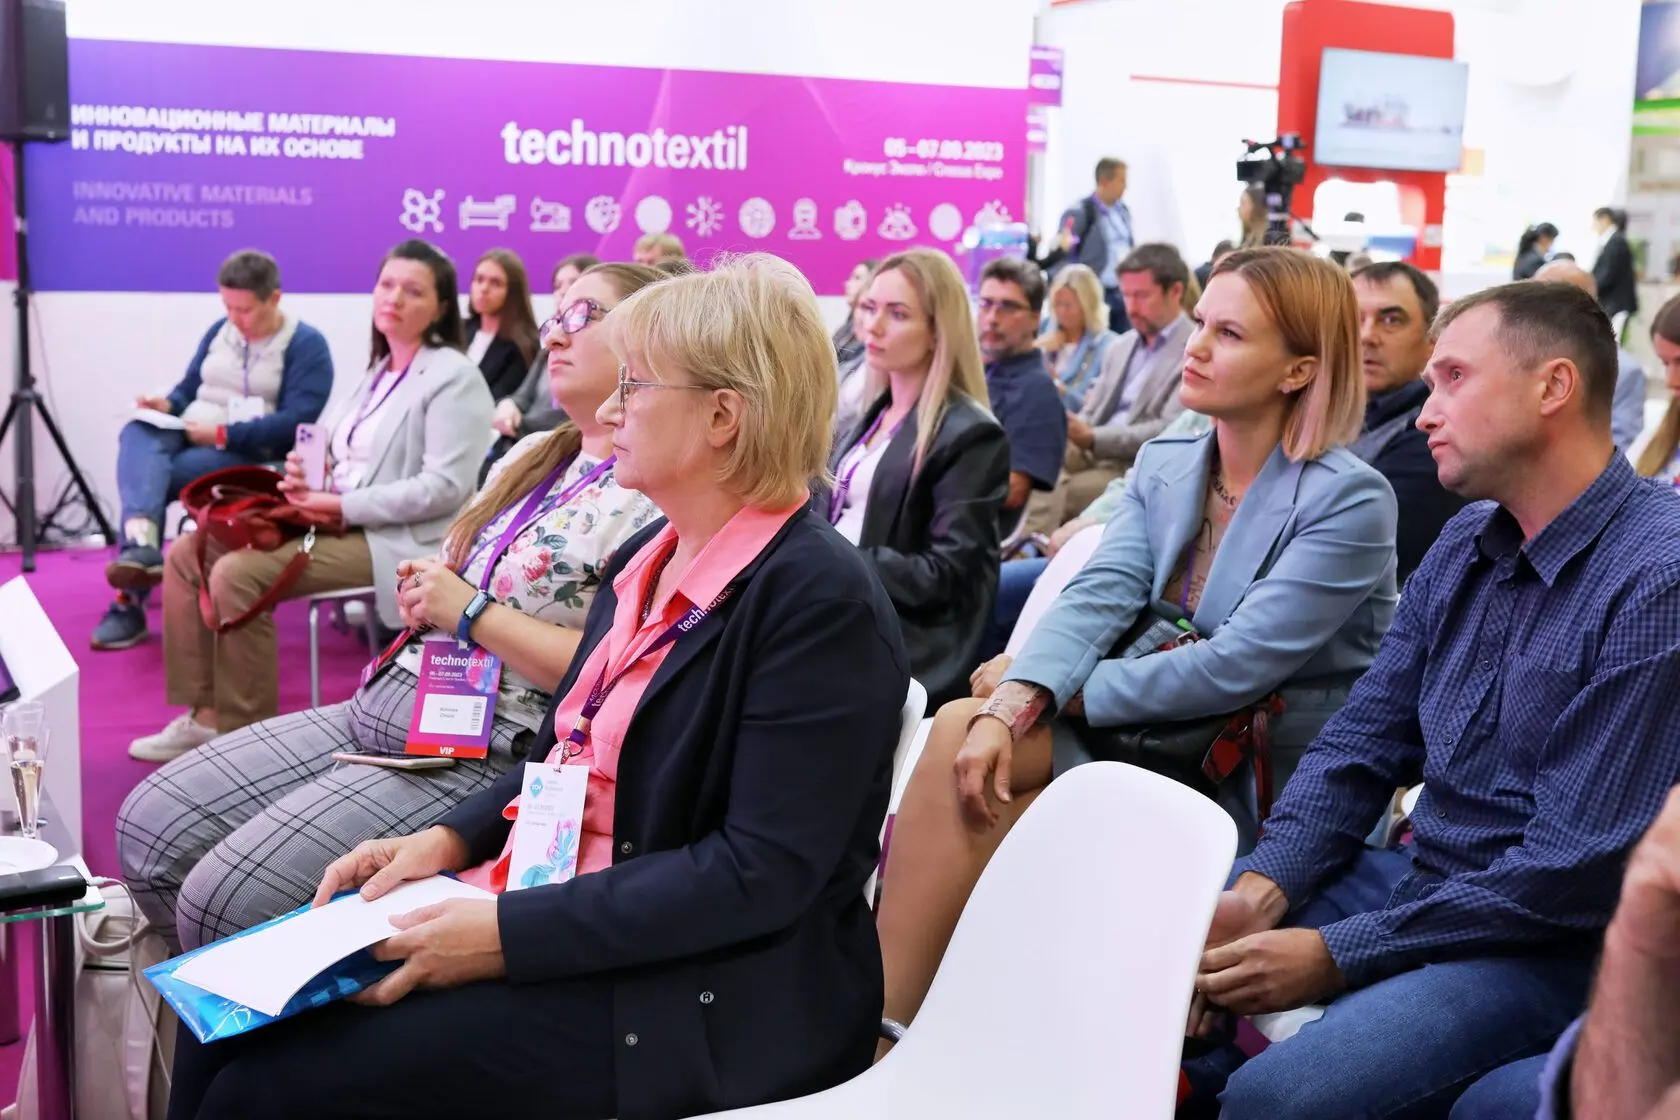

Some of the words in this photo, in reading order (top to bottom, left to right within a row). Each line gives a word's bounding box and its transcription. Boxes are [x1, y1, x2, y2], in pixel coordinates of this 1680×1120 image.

[71, 104, 264, 132] ИННОВАЦИОННЫЕ
[267, 112, 396, 137] МАТЕРИАЛЫ
[71, 128, 89, 150] И
[93, 129, 212, 155] ПРОДУКТЫ
[215, 134, 247, 156] НА
[250, 136, 280, 157] ИХ
[283, 137, 365, 159] ОСНОВЕ
[500, 118, 748, 170] technotextil
[73, 181, 195, 202] INNOVATIVE
[200, 185, 313, 206] MATERIALS
[73, 206, 120, 226] AND
[125, 207, 235, 228] PRODUCTS
[430, 654, 494, 668] technotextil
[439, 746, 455, 755] VIP
